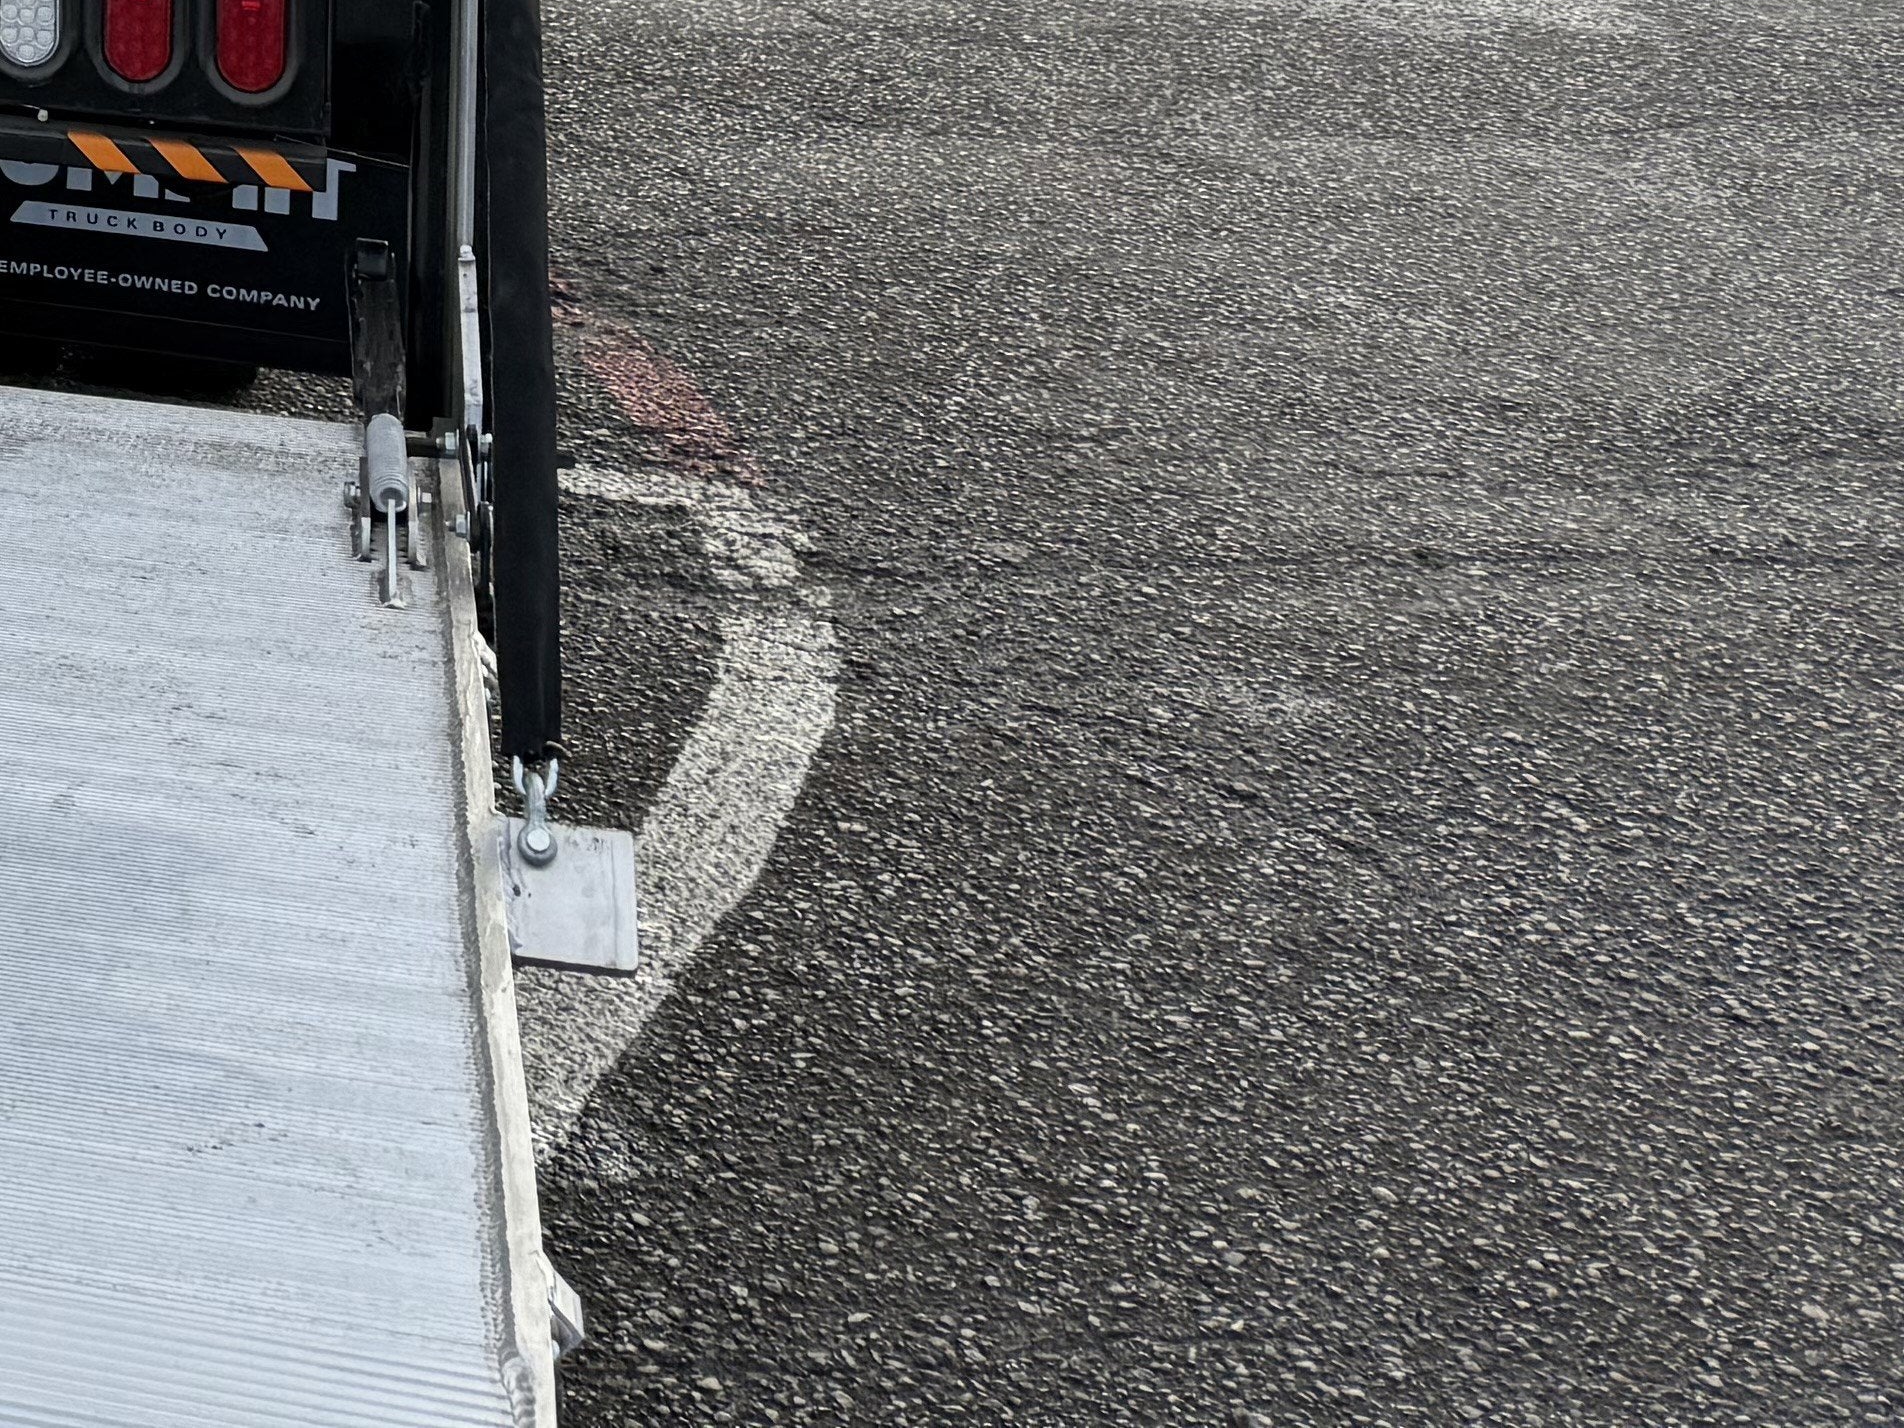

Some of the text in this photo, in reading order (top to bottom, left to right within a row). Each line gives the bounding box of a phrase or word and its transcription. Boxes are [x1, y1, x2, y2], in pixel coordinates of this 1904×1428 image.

[48, 208, 228, 241] TRUCK BODY
[206, 283, 321, 312] COMPANY
